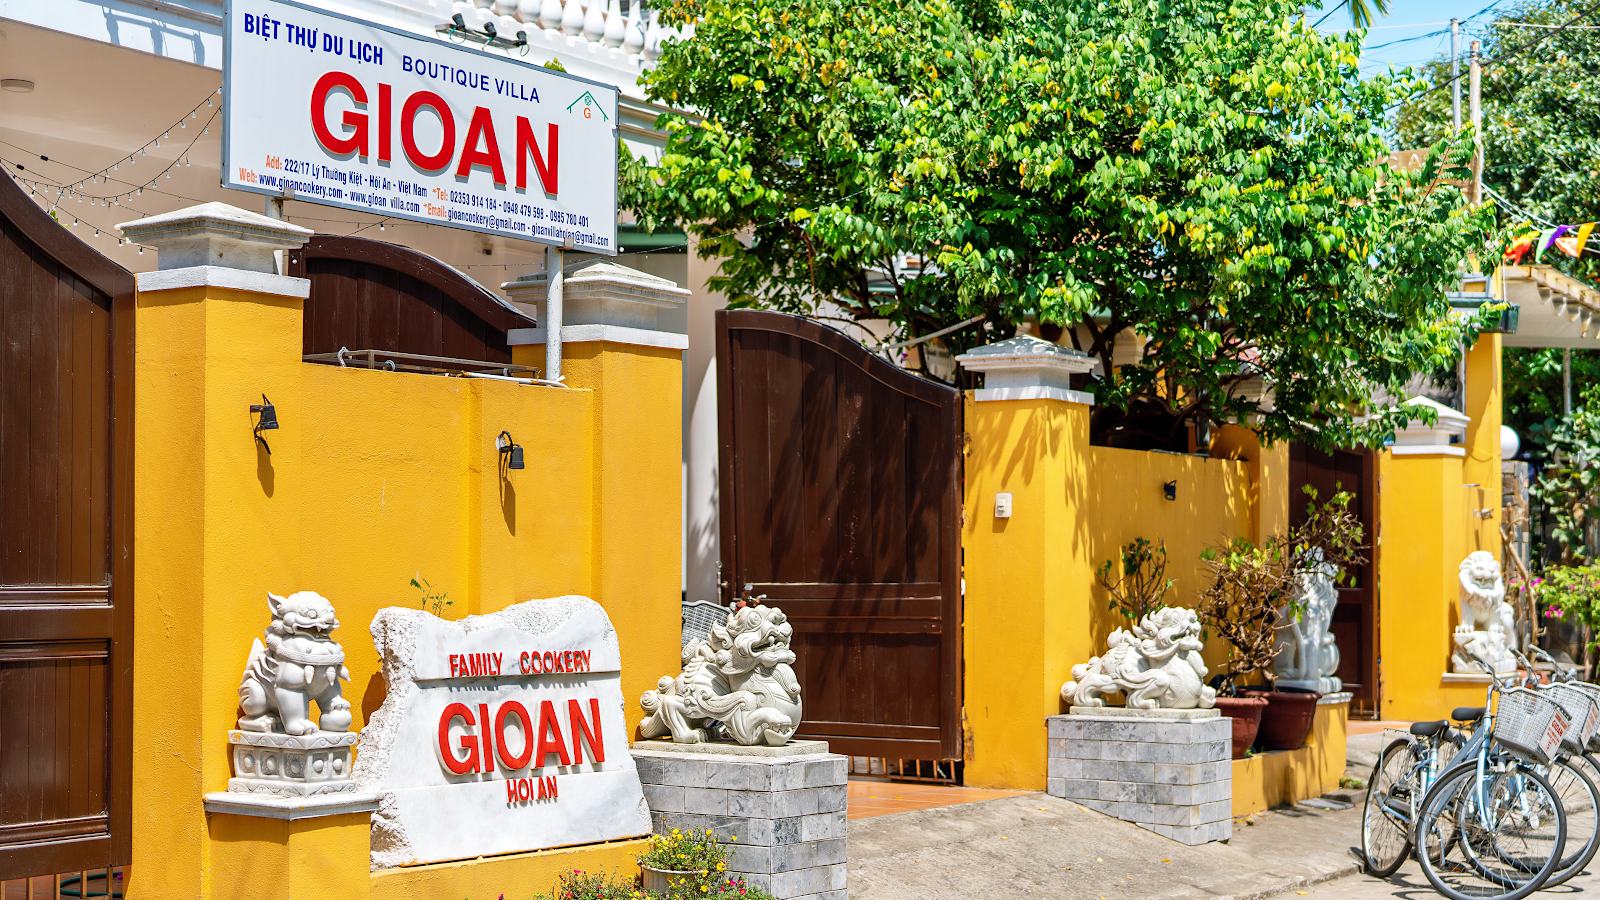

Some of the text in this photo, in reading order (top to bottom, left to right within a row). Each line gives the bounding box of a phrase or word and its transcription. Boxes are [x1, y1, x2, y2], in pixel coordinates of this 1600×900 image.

[244, 13, 383, 66] BIỆT THỰ DU LỊCH
[402, 55, 540, 104] BOUTIQUE VILLA
[310, 71, 559, 198] GIOAN
[583, 107, 592, 119] G
[238, 167, 258, 184] Web:
[259, 174, 343, 199] www.gioancookery.com
[447, 206, 526, 232] gioancookery@gmail.com
[265, 154, 282, 170] Add:
[284, 158, 310, 175] 222/17
[312, 163, 320, 180] Lý
[348, 171, 363, 187] Kiệt
[369, 174, 381, 191] Hội
[382, 177, 391, 191] An
[397, 180, 411, 196] Việt
[413, 183, 428, 198] Nam
[450, 190, 470, 206] 02353
[471, 194, 483, 208] 914
[485, 197, 497, 211] 184
[503, 200, 519, 215] 0948
[520, 204, 532, 218] 479
[578, 215, 589, 228] 401
[448, 650, 591, 678] FAMILY COOKERY
[436, 698, 606, 775] GIOAN
[506, 775, 559, 803] HOI AN
